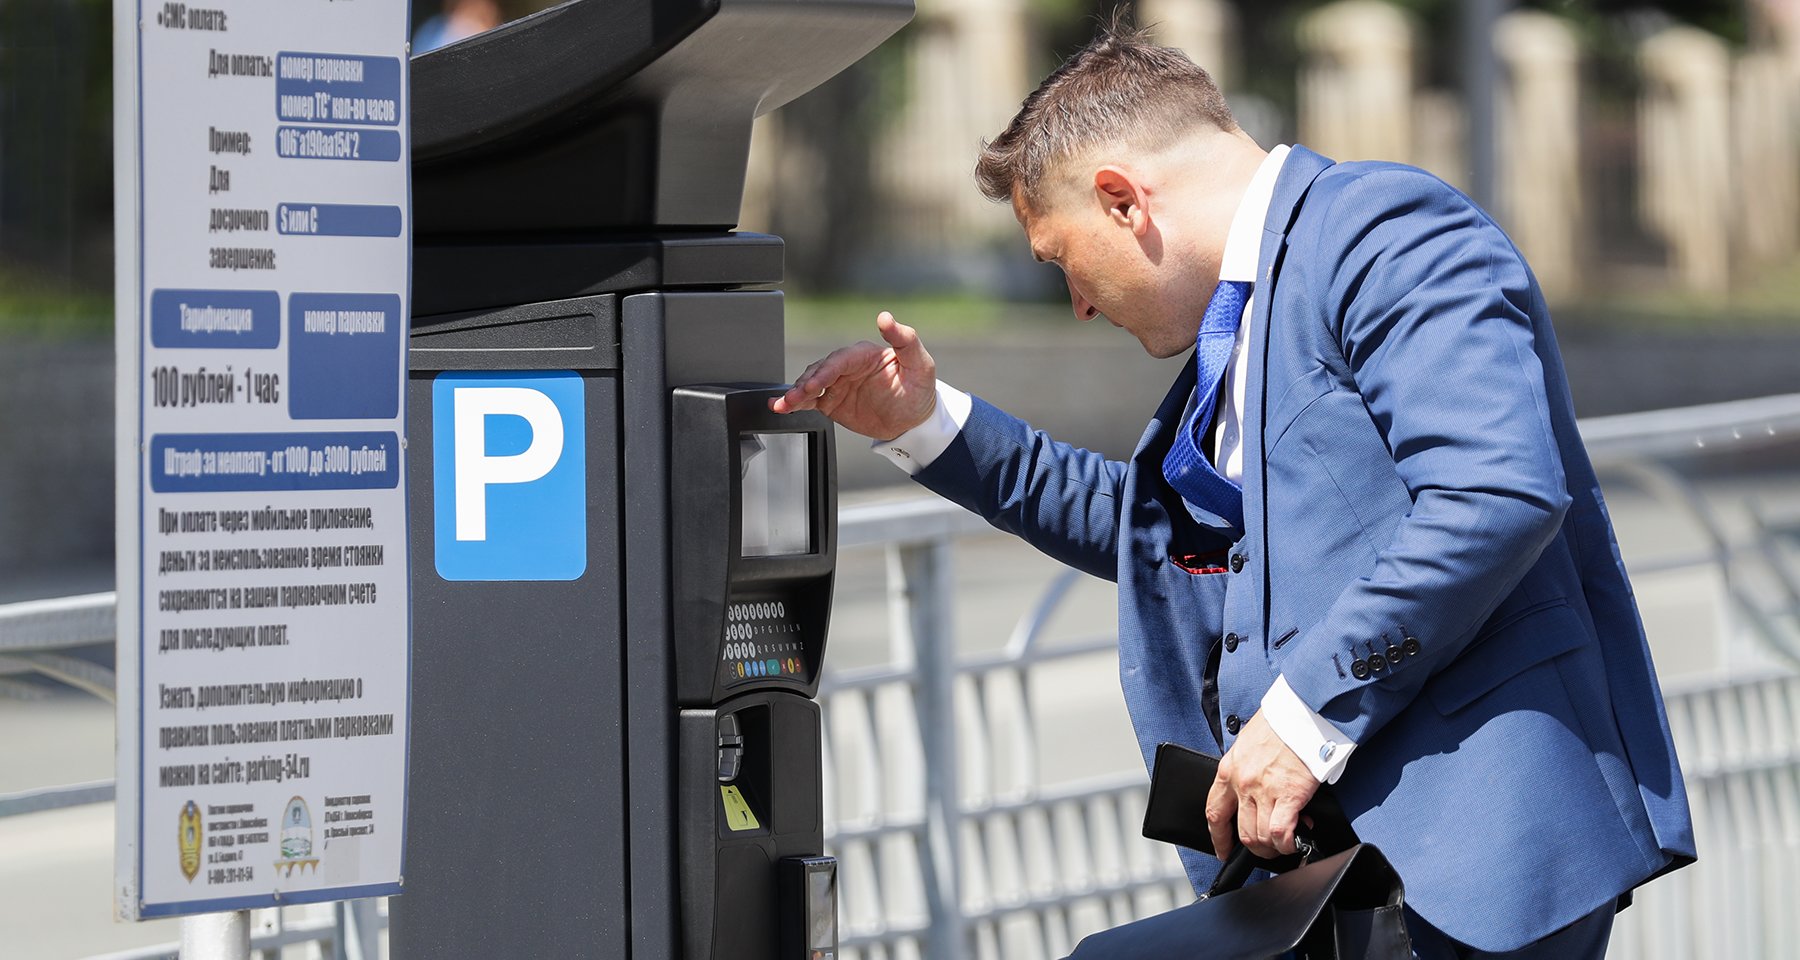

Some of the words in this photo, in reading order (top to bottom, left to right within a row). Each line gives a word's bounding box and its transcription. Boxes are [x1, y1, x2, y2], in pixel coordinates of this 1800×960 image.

[187, 9, 227, 31] оплата:
[208, 49, 229, 77] Для
[231, 54, 273, 76] оплаты:
[280, 56, 313, 82] номер
[314, 58, 363, 82] парковки
[281, 95, 314, 120] номер
[332, 97, 365, 120] кол-во
[366, 97, 395, 121] часов
[209, 127, 251, 155] Пример:
[209, 166, 230, 193] Для
[209, 209, 269, 232] досрочного
[280, 206, 287, 232] S
[288, 210, 309, 232] или
[209, 248, 276, 270] завершения:
[179, 303, 253, 333] Тарификация
[304, 311, 336, 335] номер
[337, 311, 385, 334] парковки
[152, 366, 178, 407] 100
[181, 364, 234, 407] рублей
[244, 368, 251, 404] 1
[254, 373, 280, 404] час
[164, 448, 202, 477] Штраф
[203, 450, 216, 473] за
[217, 450, 266, 476] неоплату
[271, 450, 283, 473] от
[285, 446, 308, 473] 1000
[309, 451, 323, 476] до
[324, 446, 349, 472] 3000
[350, 443, 386, 474] рублей
[454, 388, 564, 541] P
[158, 508, 178, 535] При
[180, 510, 217, 532] оплате
[218, 510, 249, 534] через
[250, 506, 308, 531] мобильное
[309, 507, 374, 531] приложение,
[158, 549, 196, 575] деньги
[198, 549, 210, 571] за
[212, 547, 309, 570] неиспользованное
[311, 545, 342, 570] время
[343, 545, 383, 566] стоянки
[158, 588, 227, 613] сохраняются
[229, 588, 241, 609] на
[243, 586, 278, 608] вашем
[280, 583, 347, 608] парковочном
[348, 582, 376, 604] счете
[159, 629, 179, 654] для
[181, 626, 256, 651] последующих
[257, 624, 289, 645] оплат.
[158, 684, 195, 709] Узнать
[196, 681, 285, 710] дополнительную
[287, 678, 354, 705] информацию
[356, 678, 362, 699] о
[159, 724, 209, 750] правилах
[210, 720, 278, 745] пользования
[280, 717, 332, 741] платными
[333, 714, 394, 740] парковками
[159, 764, 195, 787] можно
[197, 764, 210, 785] на
[211, 757, 244, 784] сайте:
[246, 754, 309, 784] parking-54.ru
